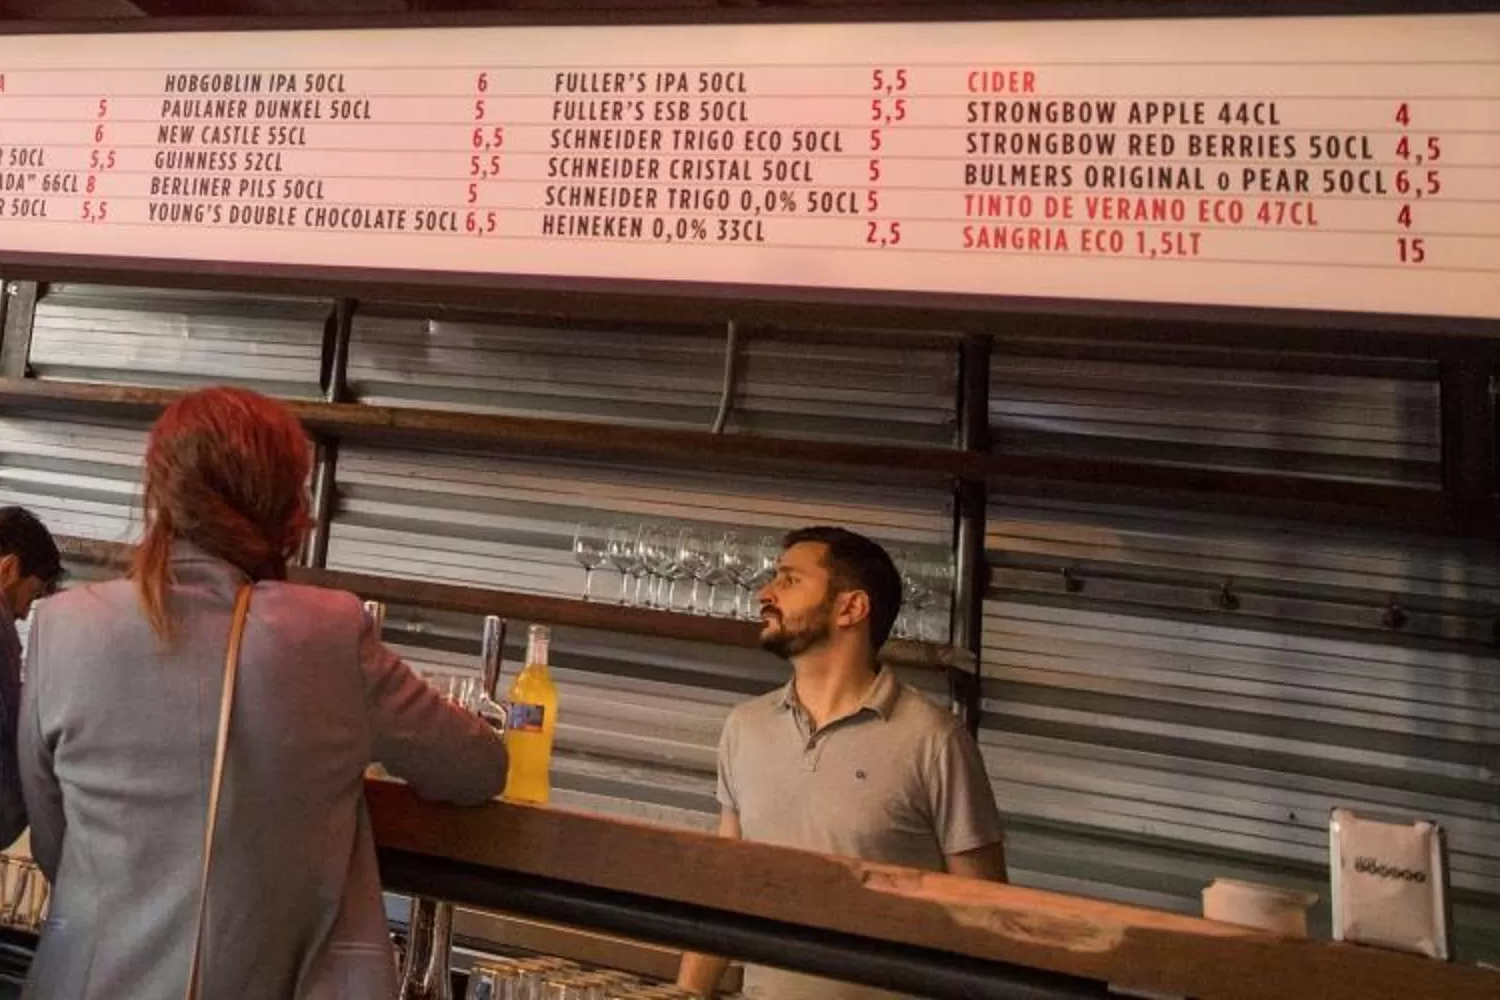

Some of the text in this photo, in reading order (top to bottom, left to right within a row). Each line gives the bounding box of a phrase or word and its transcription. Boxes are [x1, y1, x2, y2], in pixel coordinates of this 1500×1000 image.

[164, 72, 488, 93] HOBGOBLIN IPA 50CL 6
[554, 69, 908, 95] FULLER'S IPA 50CL 5,5
[968, 71, 1036, 93] CIDER
[98, 99, 108, 117] 5
[161, 99, 485, 120] PAULANER DUNKEL 50CL 5
[552, 99, 906, 125] FULLER'S ESB 50CL 5,5
[967, 101, 1410, 126] STRONGBOW APPLE 44CL 4
[94, 124, 104, 142] 6
[157, 125, 504, 151] NEW CASTLE 55CL 6,5
[550, 128, 882, 153] SCHNEIDER TRIGO ECO 50CL 5
[9, 148, 45, 167] 50CL
[90, 150, 116, 170] 5,5
[966, 132, 1441, 165] STRONGBOW RED BERRIES 50CL 4,5
[154, 151, 501, 180] GUINNESS 52CL 5,5
[547, 157, 880, 183] SCHNEIDER CRISTAL 50CL 5
[42, 174, 79, 193] 66CL
[85, 175, 96, 194] 8
[150, 176, 478, 203] BERLINER PILS 50CL 5
[964, 164, 1073, 187] BULMERS
[1084, 165, 1205, 190] ORIGINAL
[1242, 167, 1310, 192] PEAR
[1322, 169, 1387, 195] 50CL
[1395, 170, 1441, 199] 6,5
[11, 198, 47, 218] 50CL
[81, 201, 108, 224] 5,5
[545, 185, 878, 216] SCHNEIDER TRIGO 0,0% 50CL 5
[964, 194, 1412, 228] TINTO DE VERANO ECO 47CL 4
[148, 202, 497, 237] YOUNG'S DOUBLE CHOCOLATE 50CL 6,5
[542, 214, 901, 249] HEINEKEN 0,0% 33CL 2,5
[963, 225, 1425, 263] SANGRIA ECO 1,5LT 15
